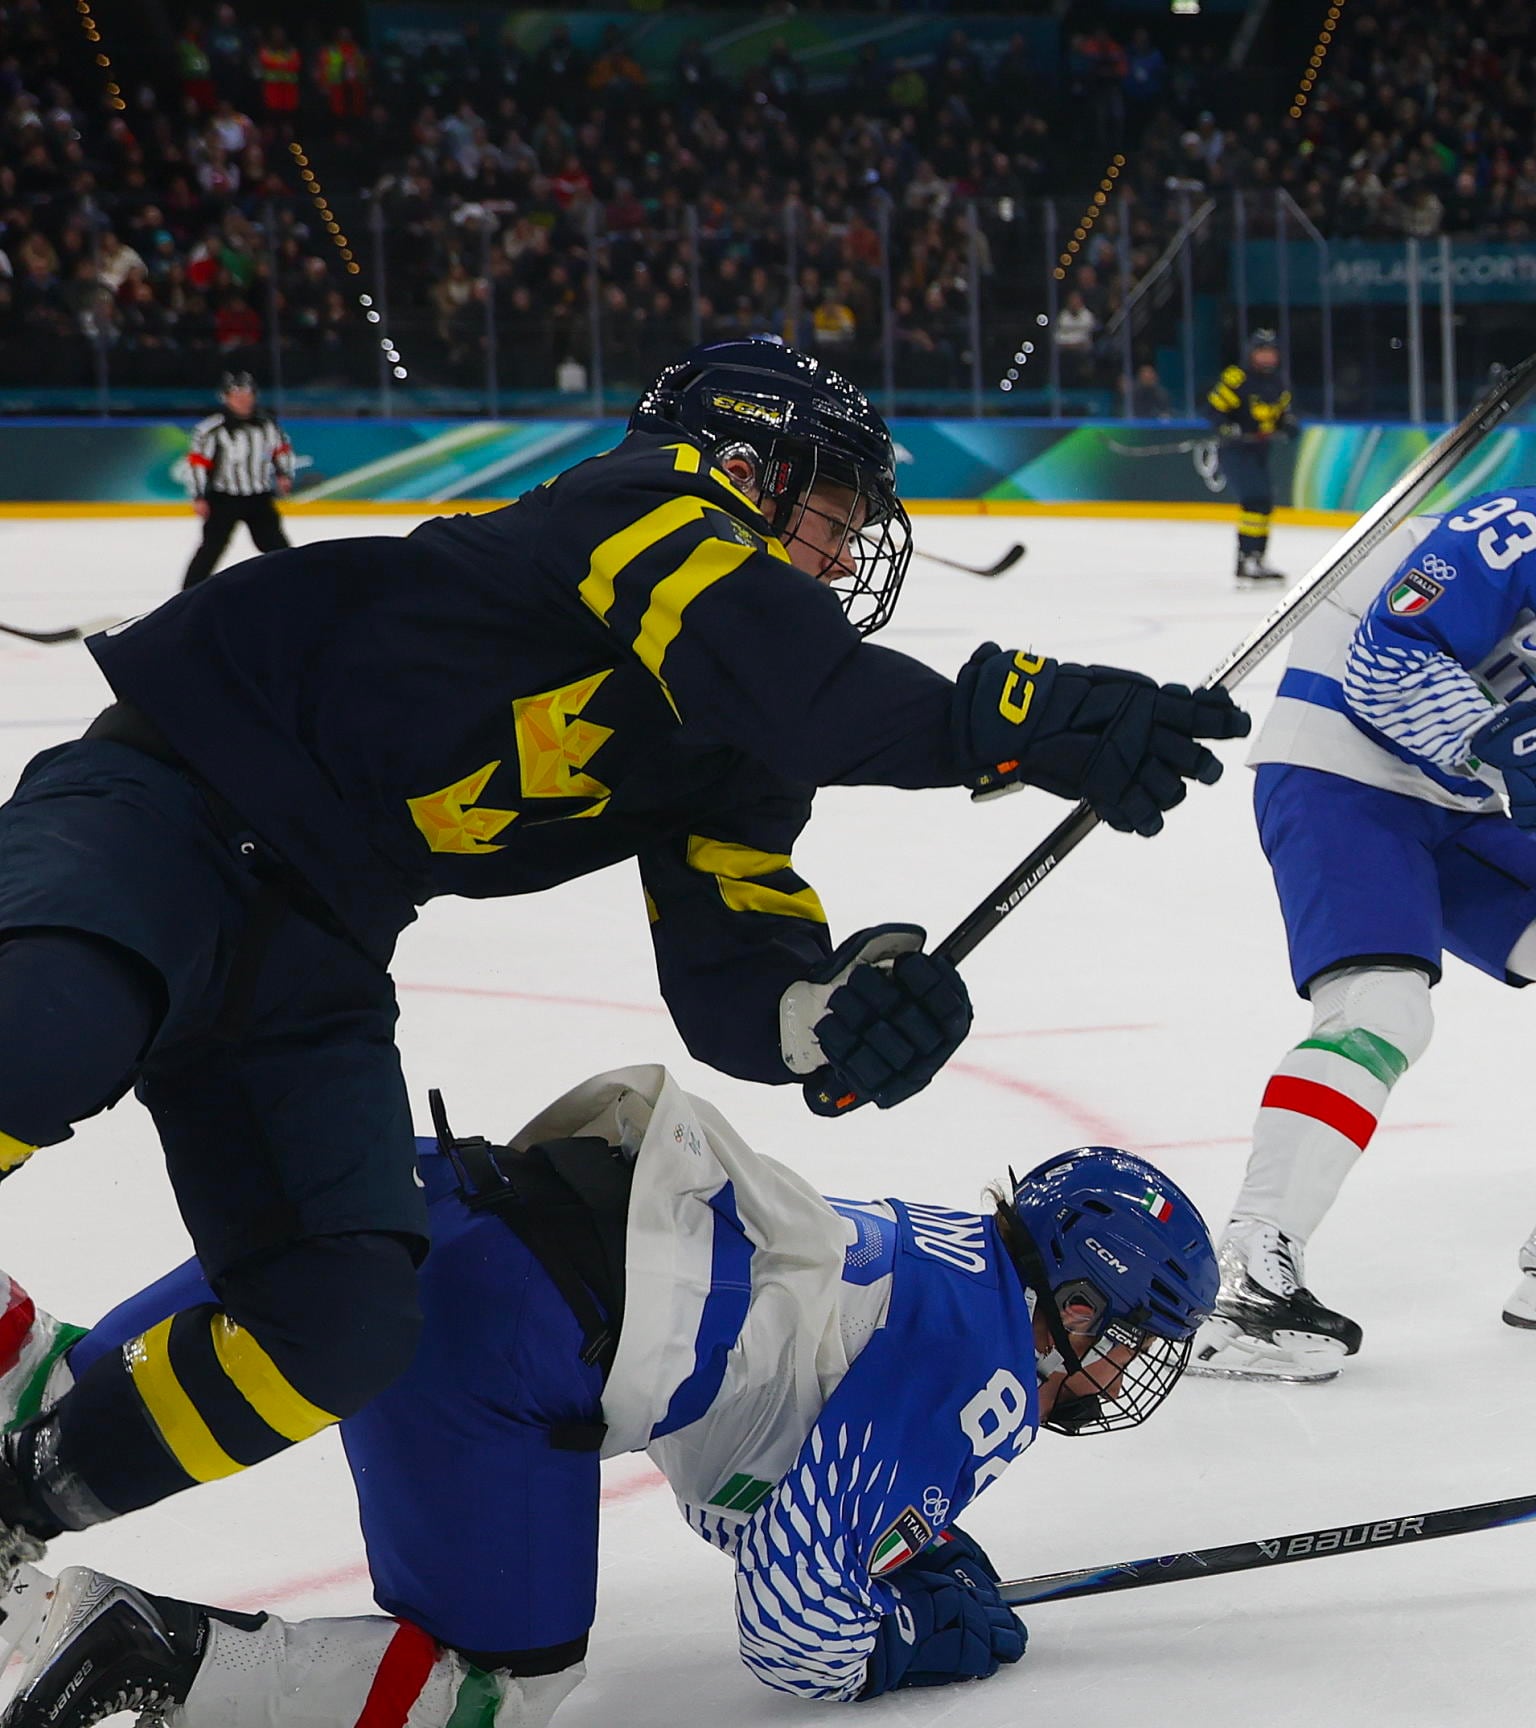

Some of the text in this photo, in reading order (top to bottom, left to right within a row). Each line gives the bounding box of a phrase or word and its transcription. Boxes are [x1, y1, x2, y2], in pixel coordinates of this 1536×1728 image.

[711, 396, 782, 423] CCM
[1406, 571, 1441, 602] ITALIA
[998, 648, 1048, 726] CC
[1008, 854, 1057, 907] BAUER
[1084, 1236, 1129, 1275] CCM
[1106, 1329, 1138, 1350] CCM
[1285, 1516, 1425, 1560] BAUER
[48, 1658, 94, 1722] BAUER
